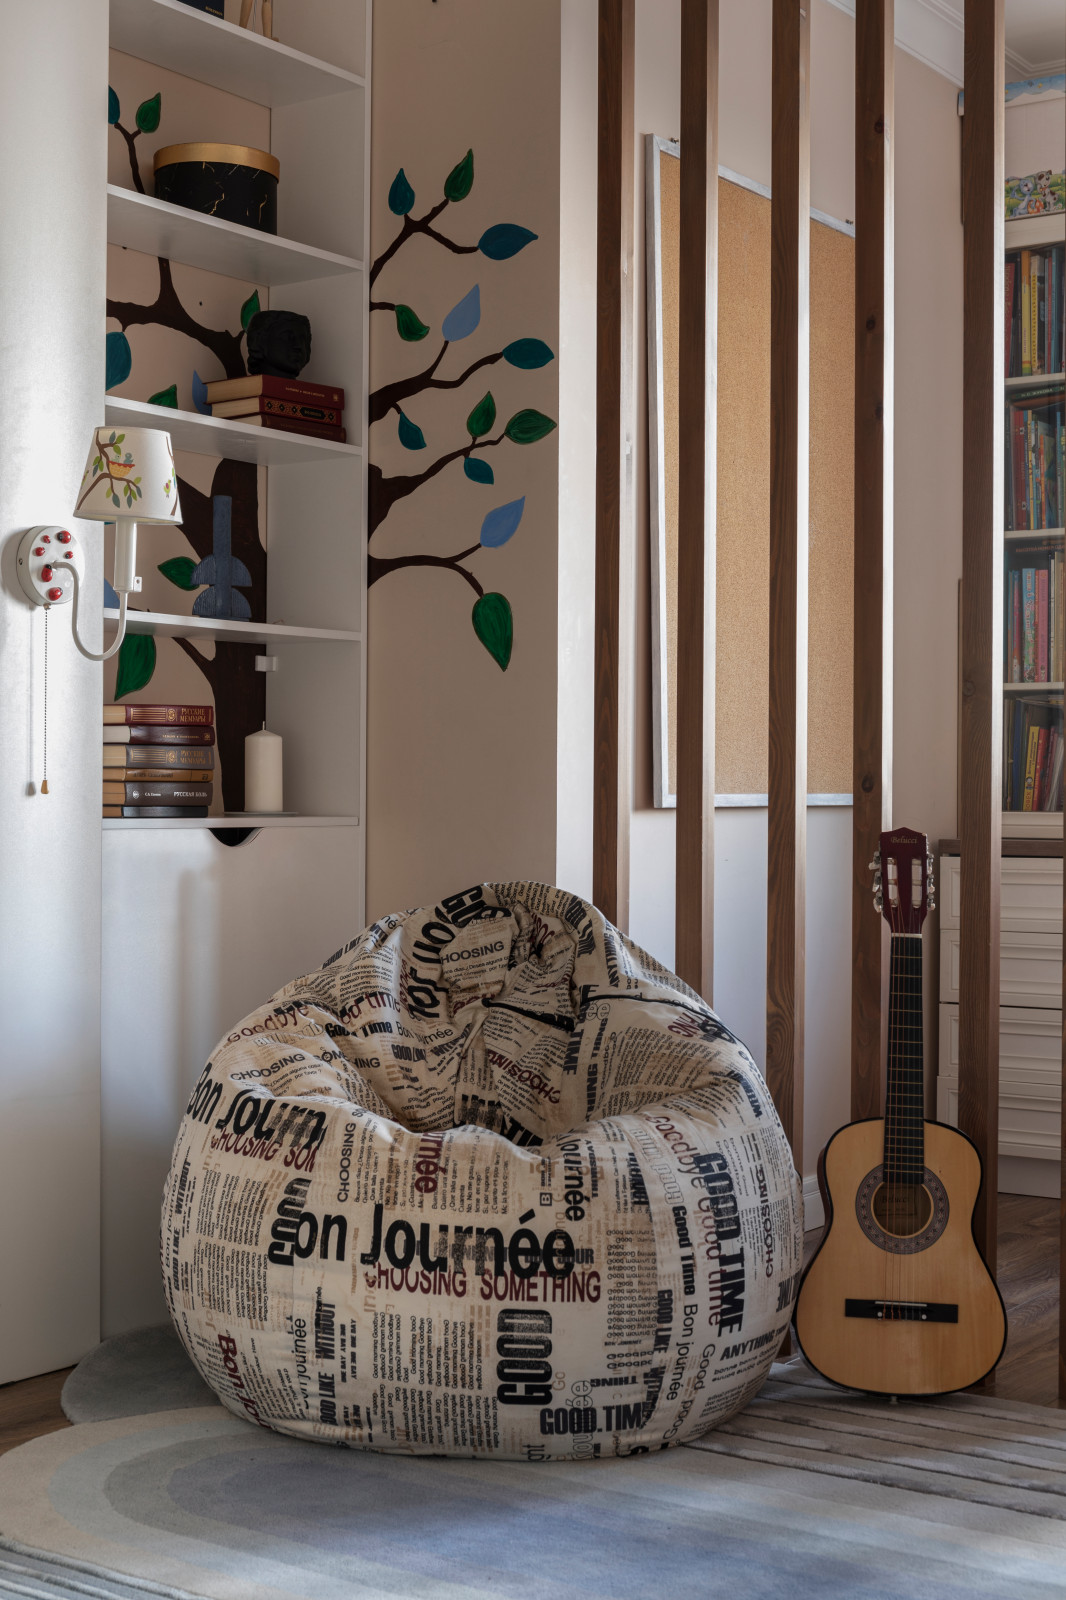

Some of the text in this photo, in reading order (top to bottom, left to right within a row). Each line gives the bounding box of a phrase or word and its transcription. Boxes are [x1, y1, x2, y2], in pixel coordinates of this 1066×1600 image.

[227, 1003, 309, 1044] Goodbye
[230, 1053, 306, 1081] CHOOSING
[562, 1028, 585, 1076] TIME
[210, 1128, 284, 1162] CHOOSING
[336, 1122, 357, 1203] CHOOSING
[645, 1115, 706, 1189] Goodbye
[174, 1160, 191, 1215] WITHOUT
[541, 1192, 552, 1206] B
[556, 1137, 591, 1222] Journée
[294, 1203, 575, 1279] on Journée
[755, 1166, 774, 1278] CHOOSING
[364, 1262, 601, 1304] CHOOSING SOMETHING
[666, 1205, 698, 1401] Good Time Bon journée
[717, 1245, 746, 1338] TIME
[291, 1318, 312, 1380] journée
[314, 1301, 336, 1361] WITHOUT
[652, 1289, 673, 1354] GOOD LIKE
[720, 1329, 775, 1362] ANYTHING
[217, 1334, 246, 1390] Bon
[318, 1371, 336, 1398] LIKE
[496, 1308, 553, 1406] GOOD
[590, 1375, 638, 1388] THING
[693, 1343, 716, 1391] Good
[662, 1398, 693, 1441] Good
